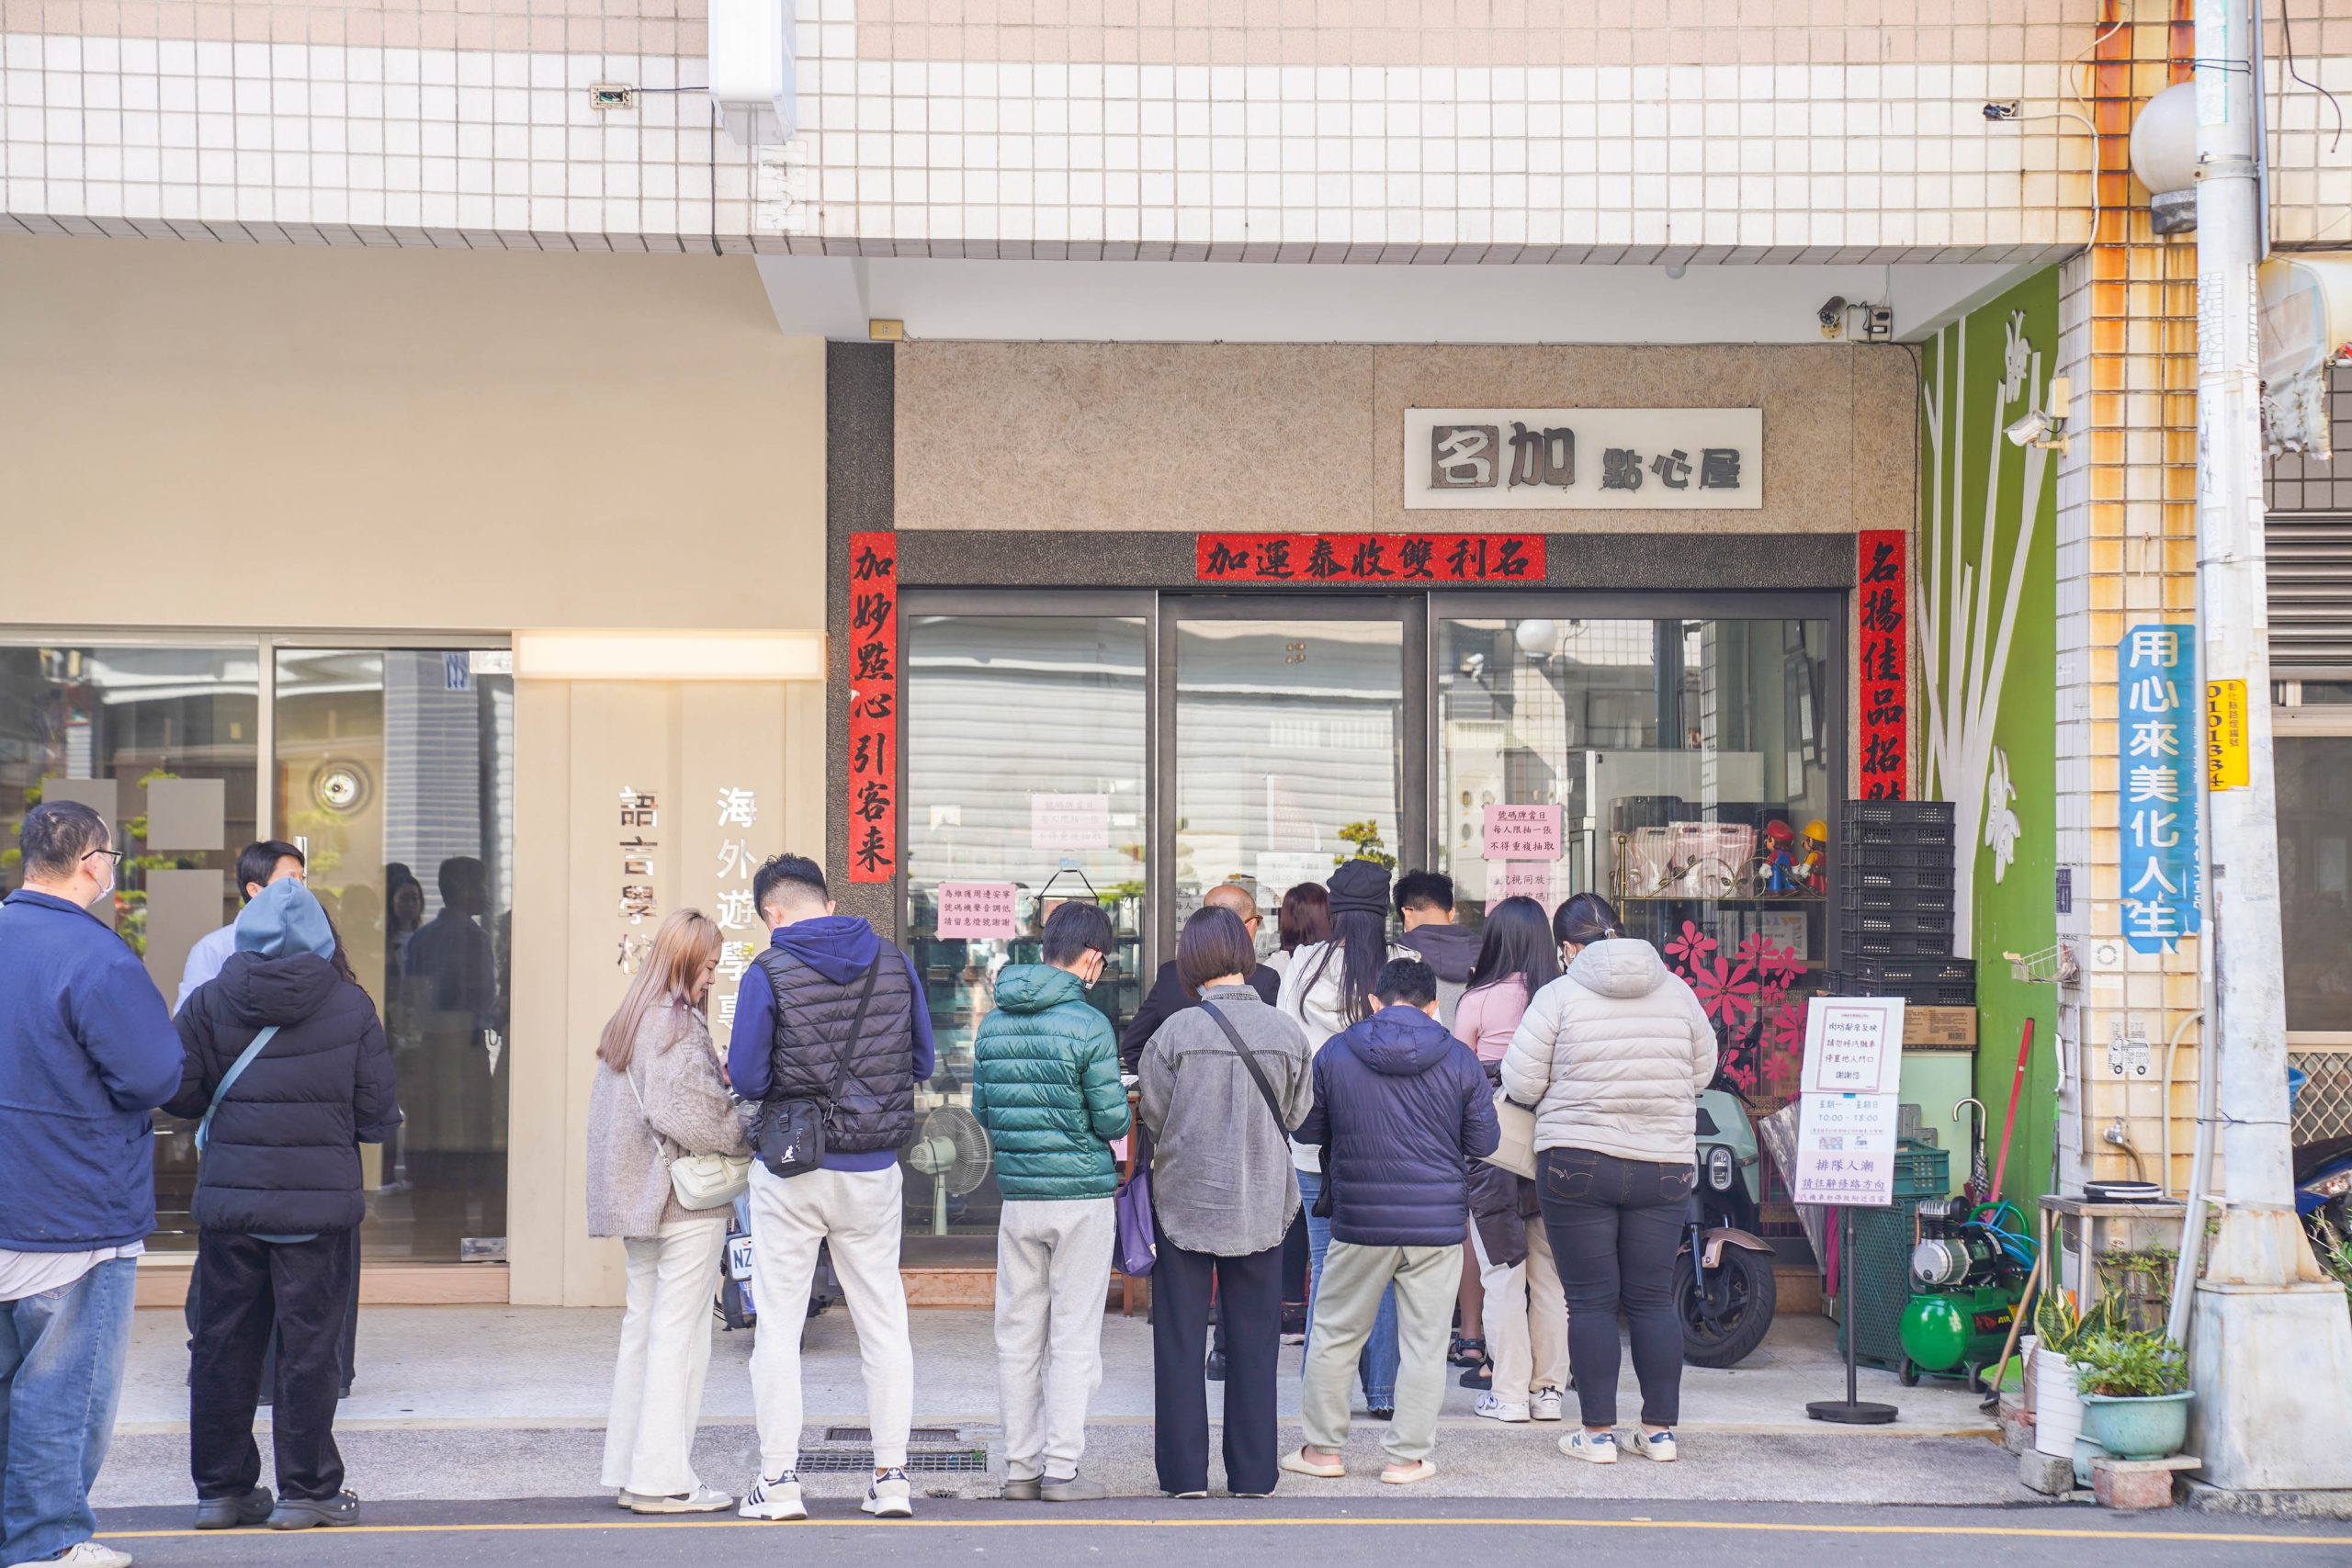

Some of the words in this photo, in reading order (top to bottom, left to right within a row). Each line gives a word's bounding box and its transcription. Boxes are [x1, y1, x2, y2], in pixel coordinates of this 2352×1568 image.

[1431, 422, 1575, 489] 名加
[1603, 448, 1741, 490] 點心屋
[2129, 631, 2179, 937] 用心來美化人生
[1498, 810, 1546, 820] 號碼牌當日
[1493, 825, 1552, 835] 每人限抽一張
[1489, 841, 1555, 852] 不得重複抽取
[1815, 1159, 1874, 1172] 排隊人潮
